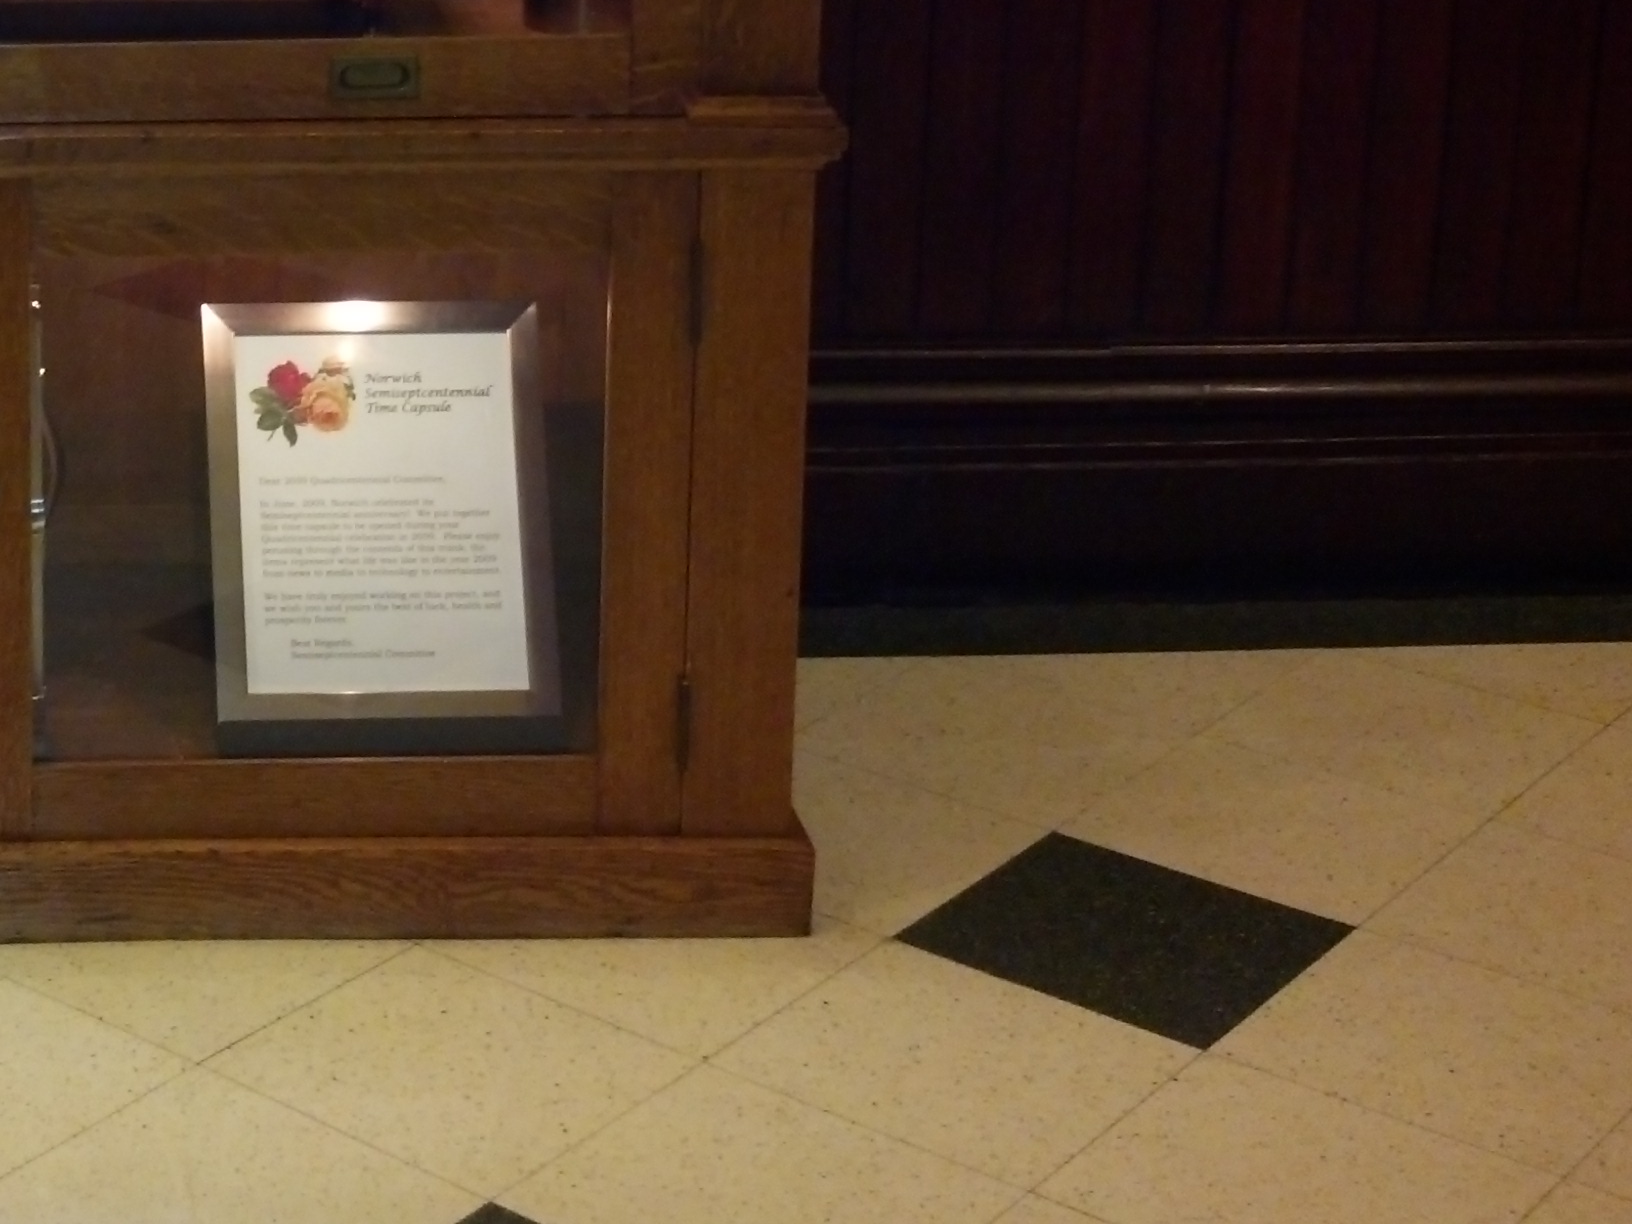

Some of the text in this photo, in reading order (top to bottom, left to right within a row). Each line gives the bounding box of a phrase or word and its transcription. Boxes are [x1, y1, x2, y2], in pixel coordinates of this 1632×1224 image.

[364, 372, 422, 384] Norwich
[365, 385, 493, 401] Semiseptcentennial
[367, 400, 452, 416] Time Capsule
